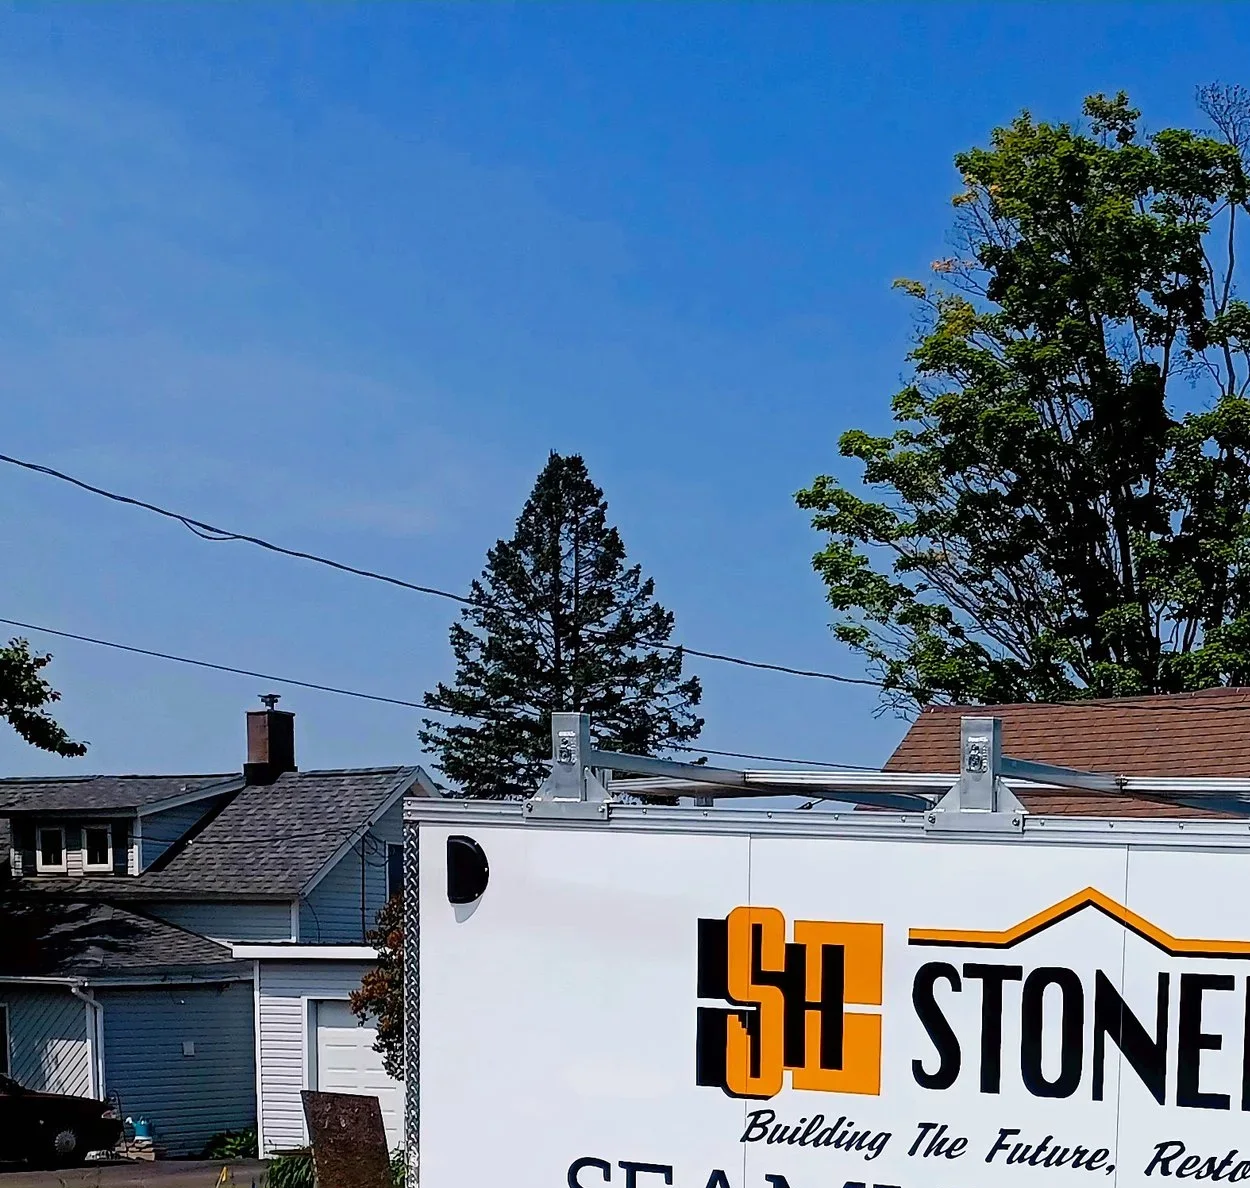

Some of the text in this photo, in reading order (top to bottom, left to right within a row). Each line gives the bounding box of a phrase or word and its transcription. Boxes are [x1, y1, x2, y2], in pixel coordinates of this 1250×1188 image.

[739, 1108, 893, 1161] Building
[907, 1122, 969, 1160] The
[984, 1127, 1117, 1175] Future,
